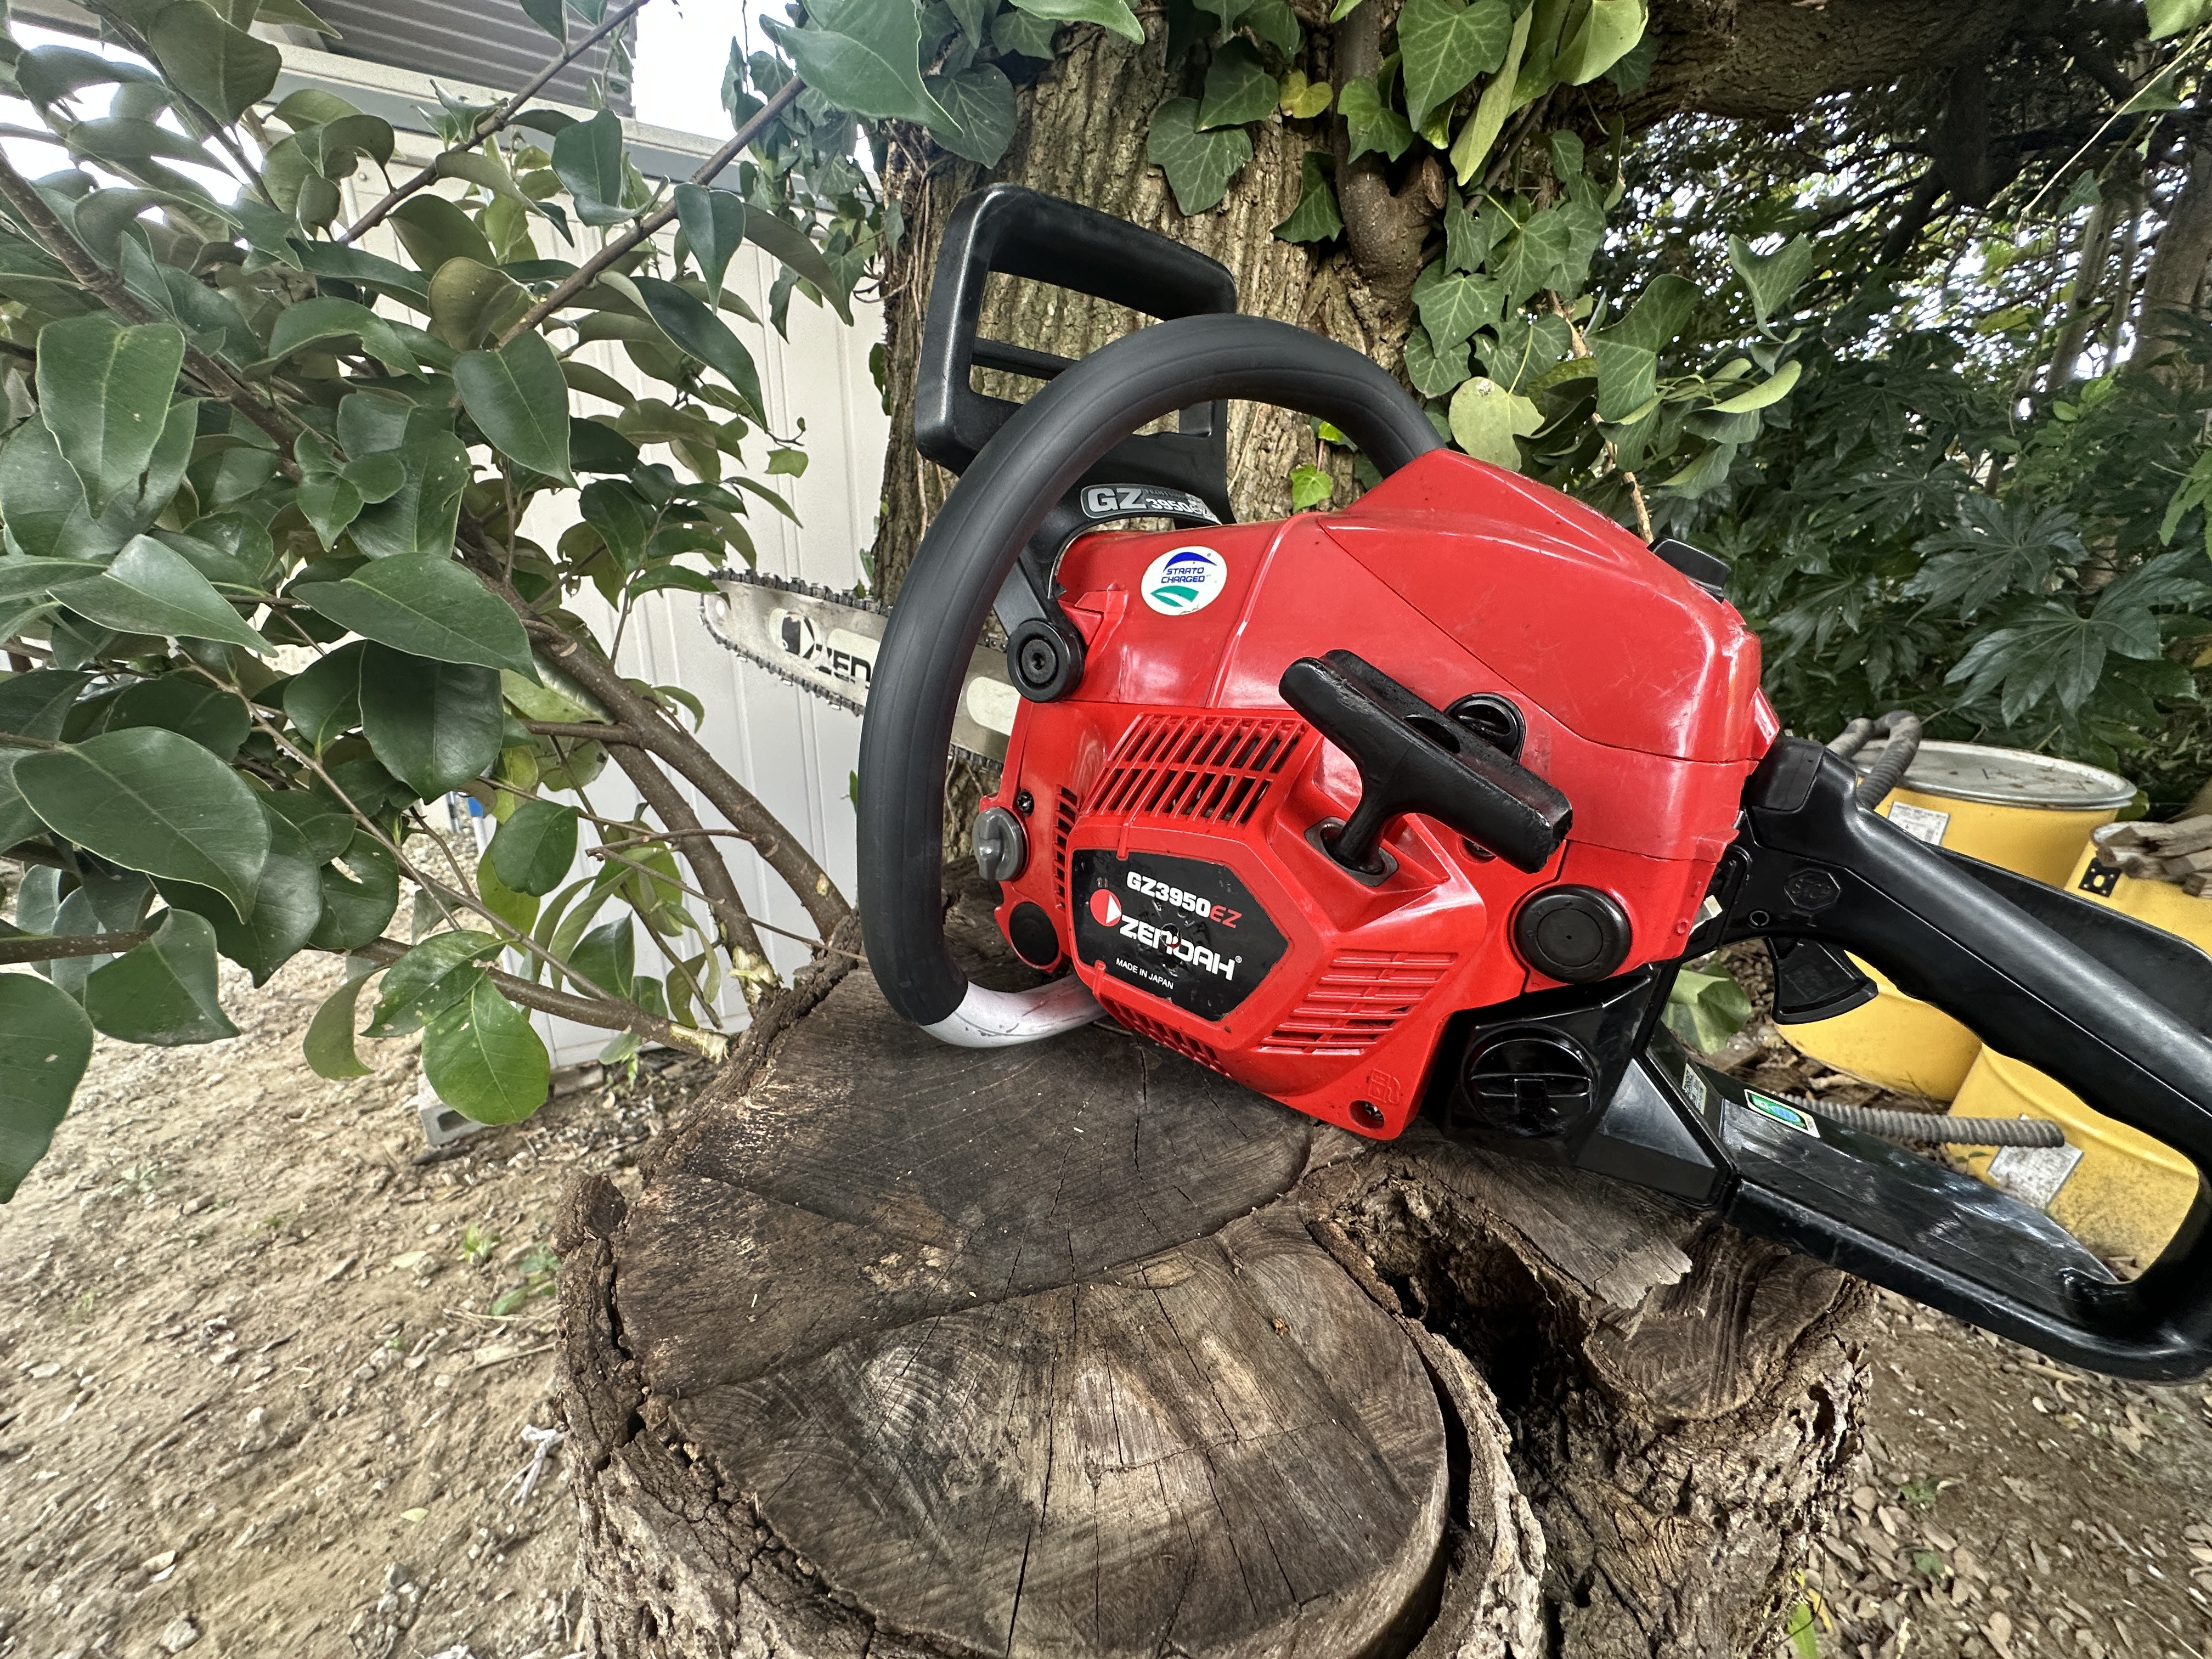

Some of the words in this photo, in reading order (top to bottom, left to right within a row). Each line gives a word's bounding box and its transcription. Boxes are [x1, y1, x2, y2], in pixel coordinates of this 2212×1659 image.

[1087, 487, 1147, 512] GZ
[815, 644, 871, 689] ZEN
[1126, 871, 1242, 928] GZ3950EZ
[1116, 957, 1138, 974] MADE
[1139, 968, 1148, 978] IN
[1148, 973, 1174, 989] JAPAN
